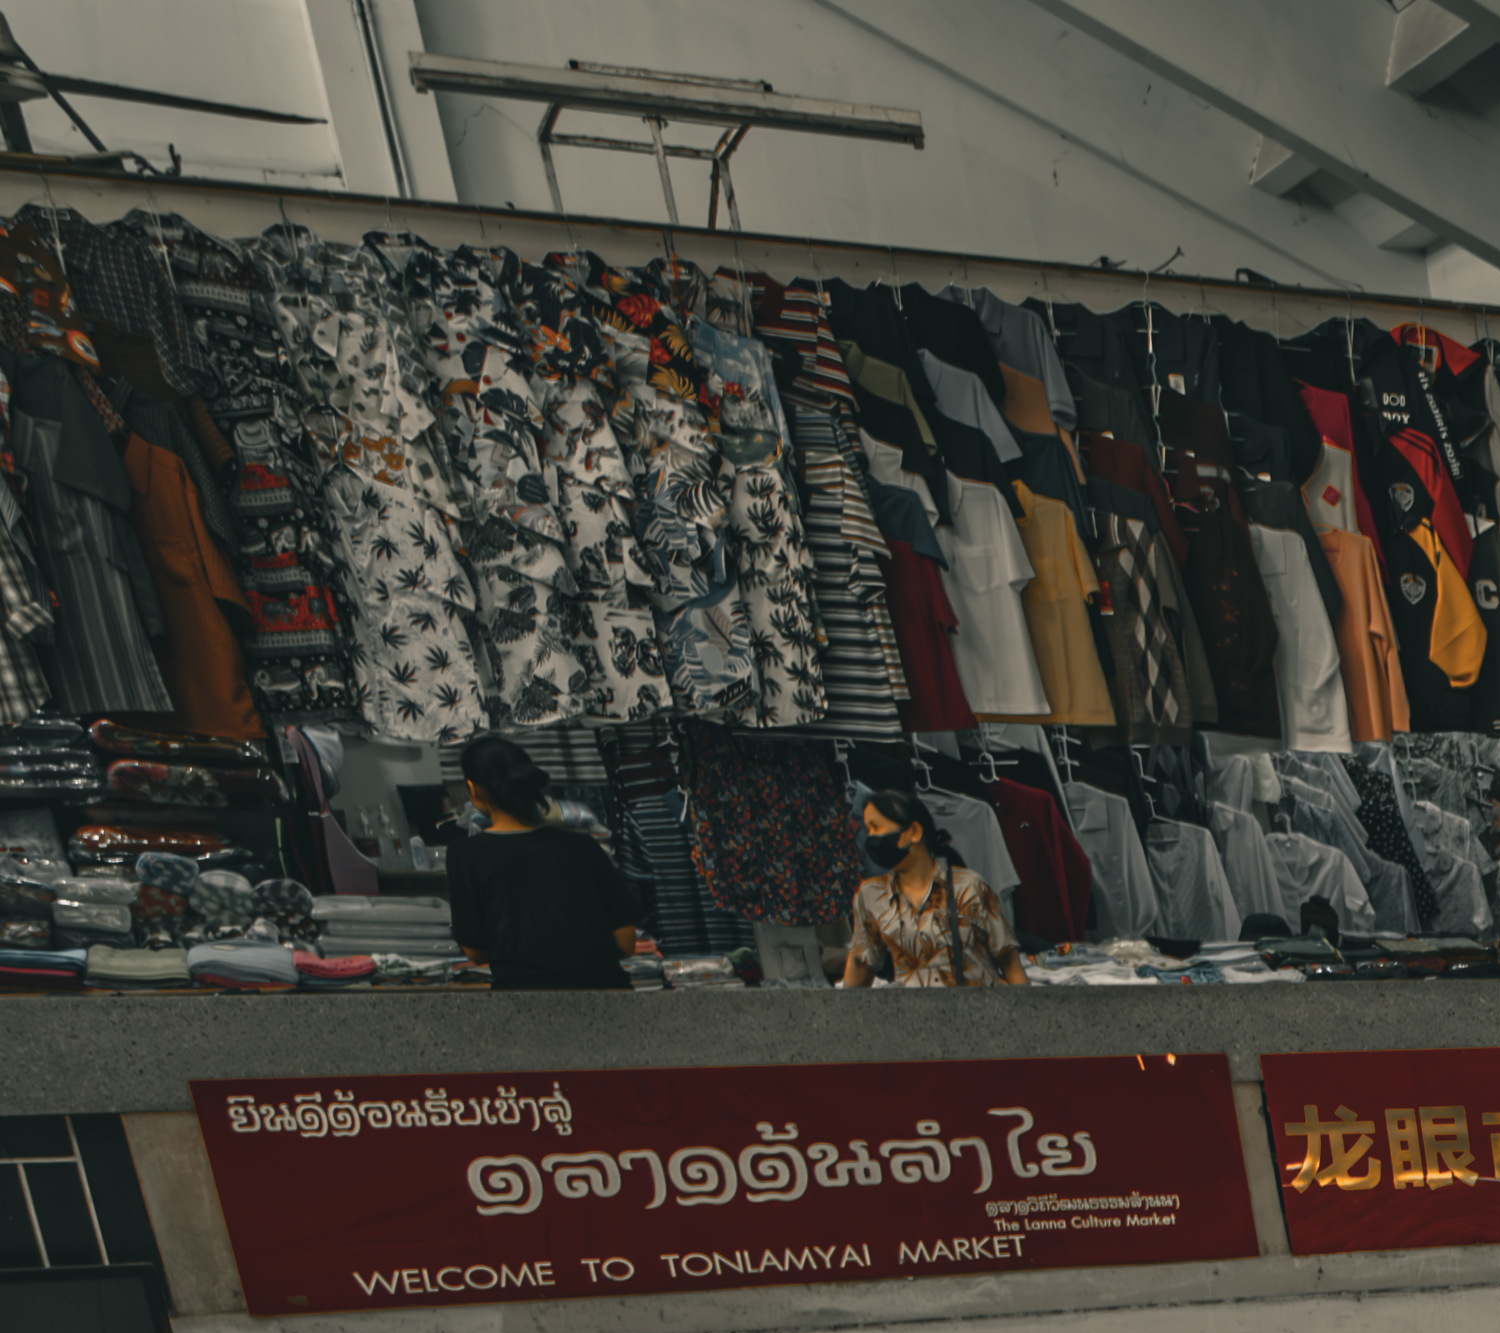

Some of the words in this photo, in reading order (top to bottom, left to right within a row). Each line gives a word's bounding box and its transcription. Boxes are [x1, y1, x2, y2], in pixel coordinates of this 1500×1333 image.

[467, 1106, 1098, 1216] ตลาดต้นลำไย
[993, 1219, 1020, 1232] The
[1024, 1217, 1067, 1231] Lanna
[1071, 1215, 1121, 1230] Culture
[1126, 1213, 1177, 1228] Market
[352, 1261, 556, 1296] WELCOME
[581, 1256, 635, 1282] TO
[660, 1243, 872, 1278] TONLAMYAI
[898, 1234, 1027, 1266] MARKET
